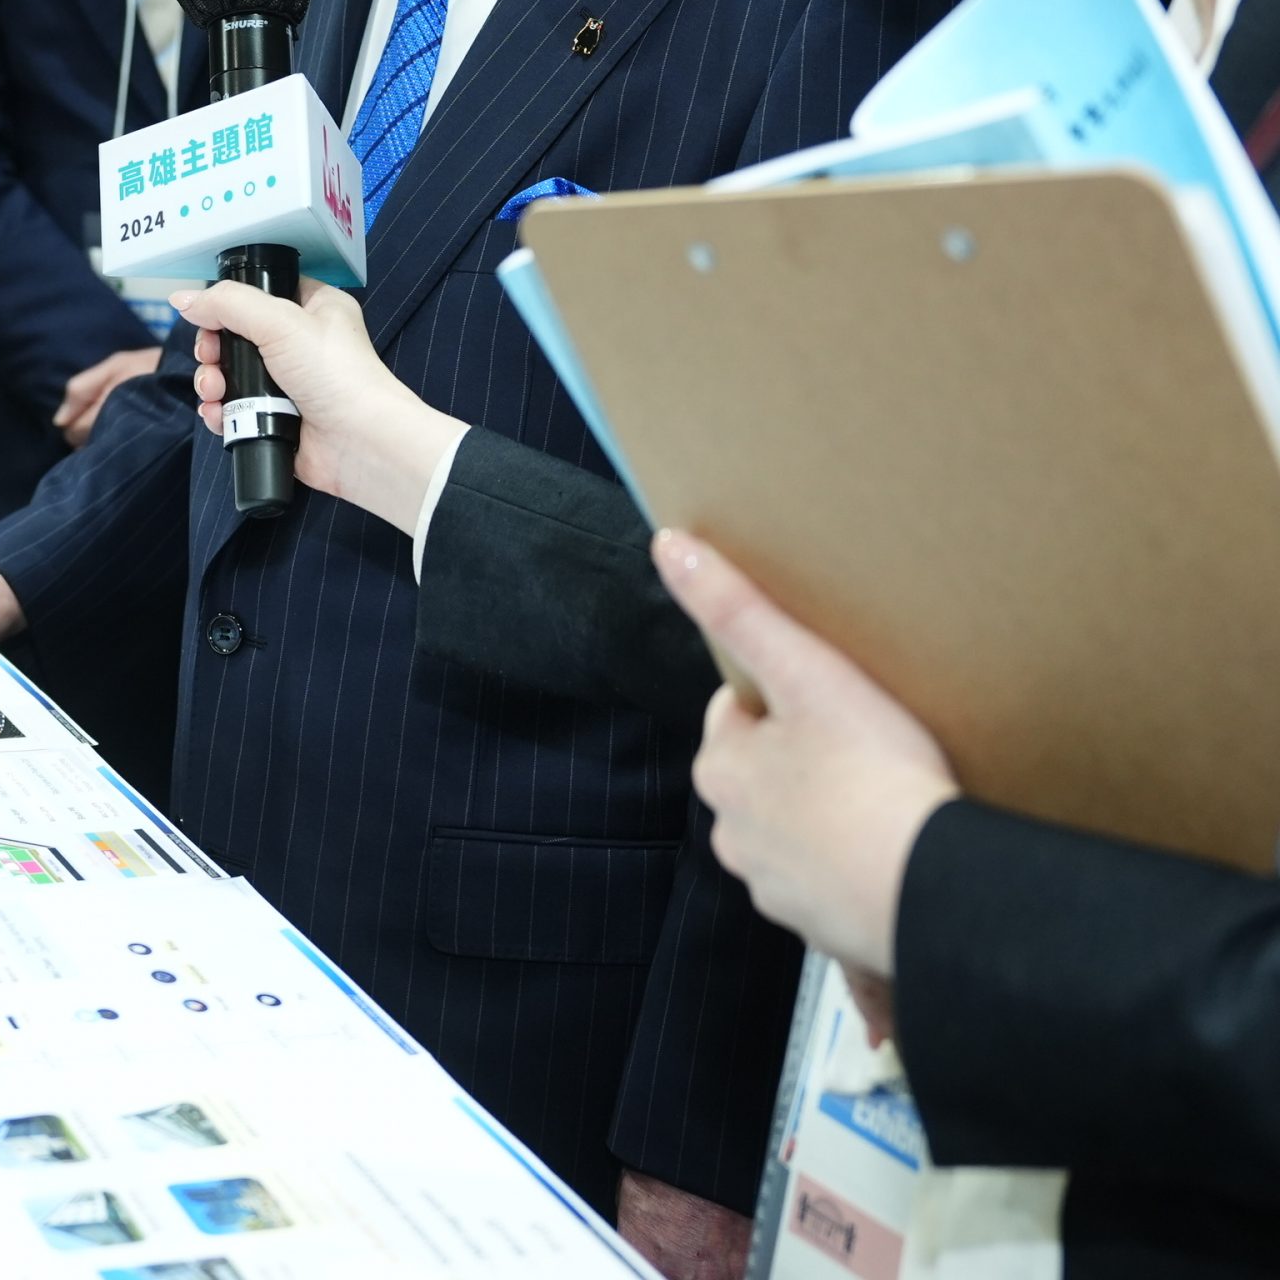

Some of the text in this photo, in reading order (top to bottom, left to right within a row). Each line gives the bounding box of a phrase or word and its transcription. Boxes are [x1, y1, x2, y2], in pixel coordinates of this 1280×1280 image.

[118, 112, 274, 201] 高雄主題館
[120, 210, 166, 243] 2024
[231, 419, 238, 433] 1
